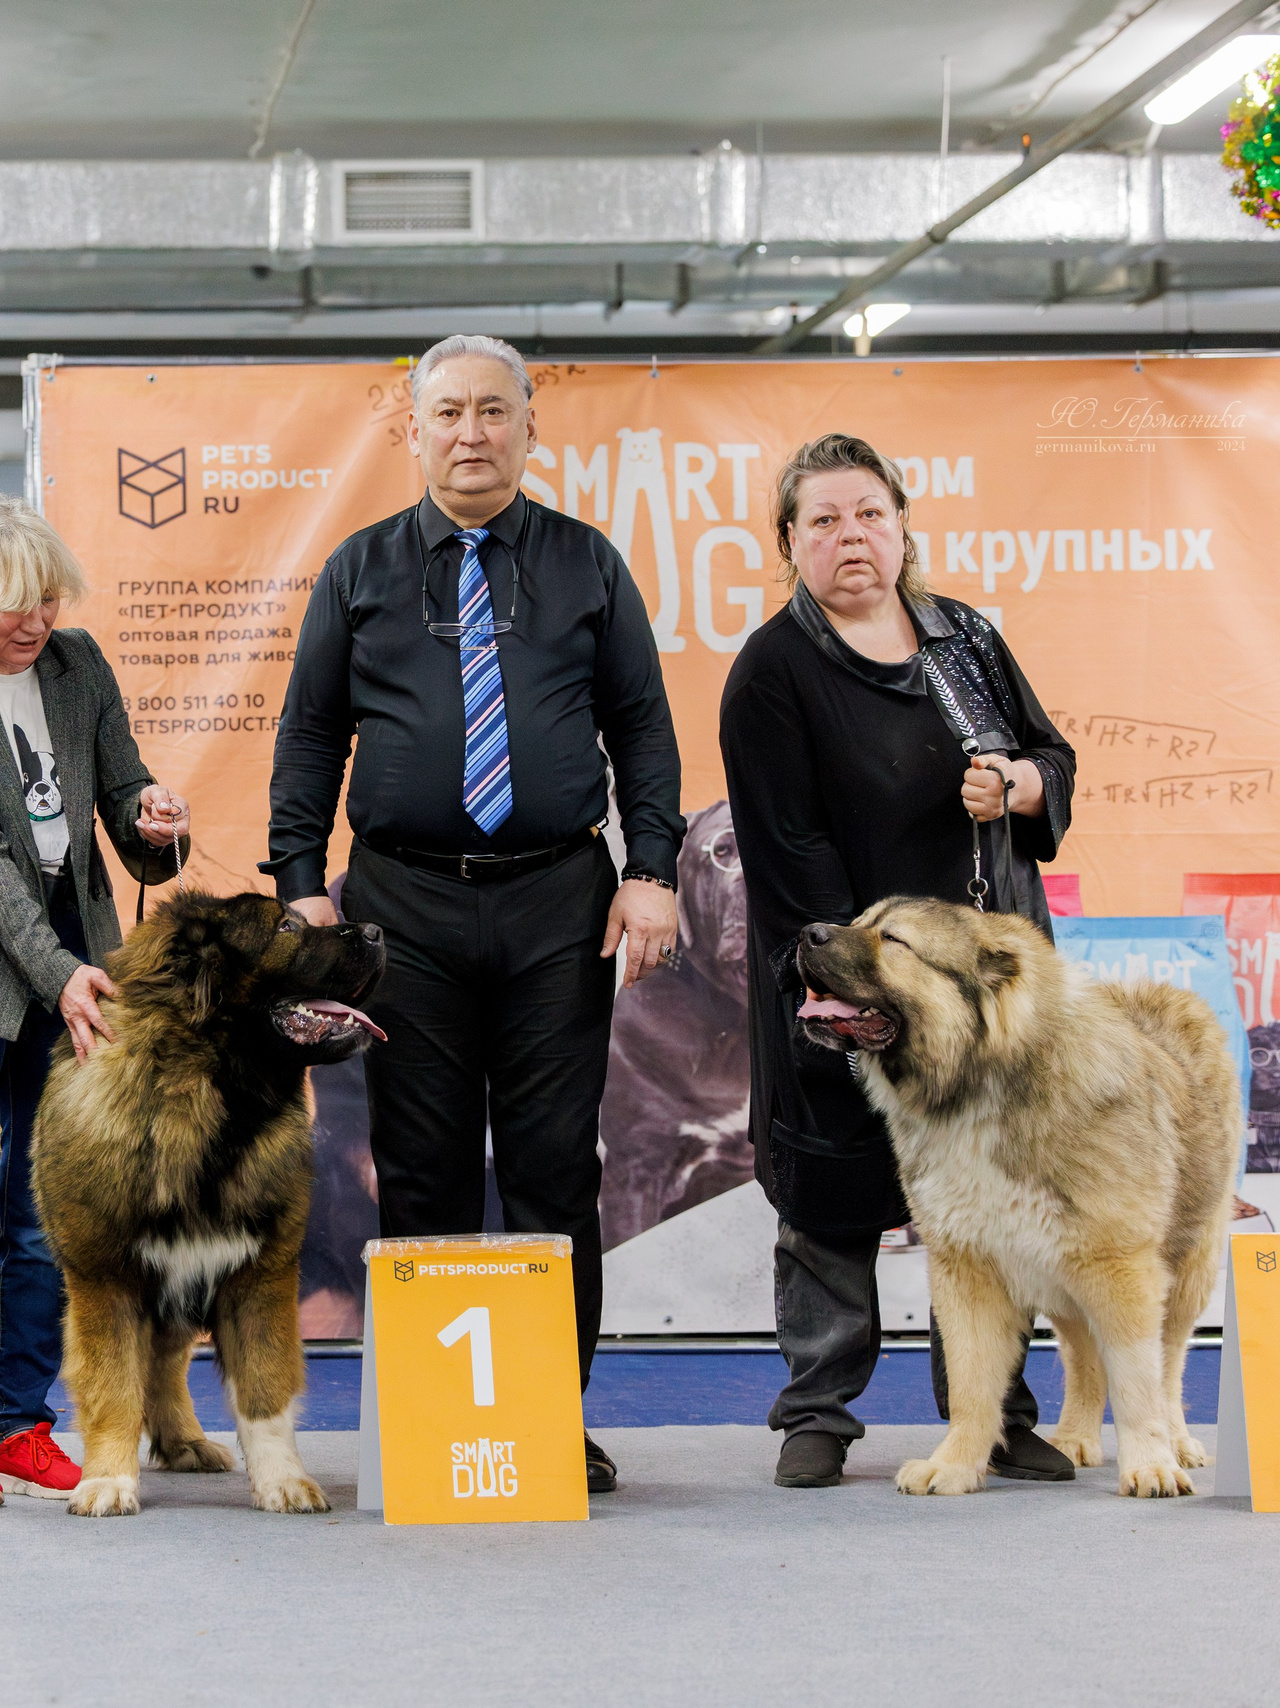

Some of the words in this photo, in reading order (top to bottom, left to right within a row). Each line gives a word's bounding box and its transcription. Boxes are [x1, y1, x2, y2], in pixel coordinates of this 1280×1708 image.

[202, 445, 271, 465] PETS
[202, 468, 332, 490] PRODUCT
[204, 496, 240, 514] RU
[945, 528, 1215, 594] крупных
[119, 580, 199, 596] ГРУППА
[119, 601, 287, 619] «ПЕТ-ПРОДУКТ»
[119, 629, 199, 642] оптовая
[205, 627, 293, 643] продажа
[119, 652, 200, 668] товаров
[205, 652, 241, 665] для
[248, 650, 296, 663] живо
[138, 696, 176, 711] 800
[183, 695, 208, 710] 511
[214, 694, 239, 708] 40
[245, 693, 265, 708] 10
[436, 1306, 496, 1406] 1
[450, 1437, 516, 1464] SMART
